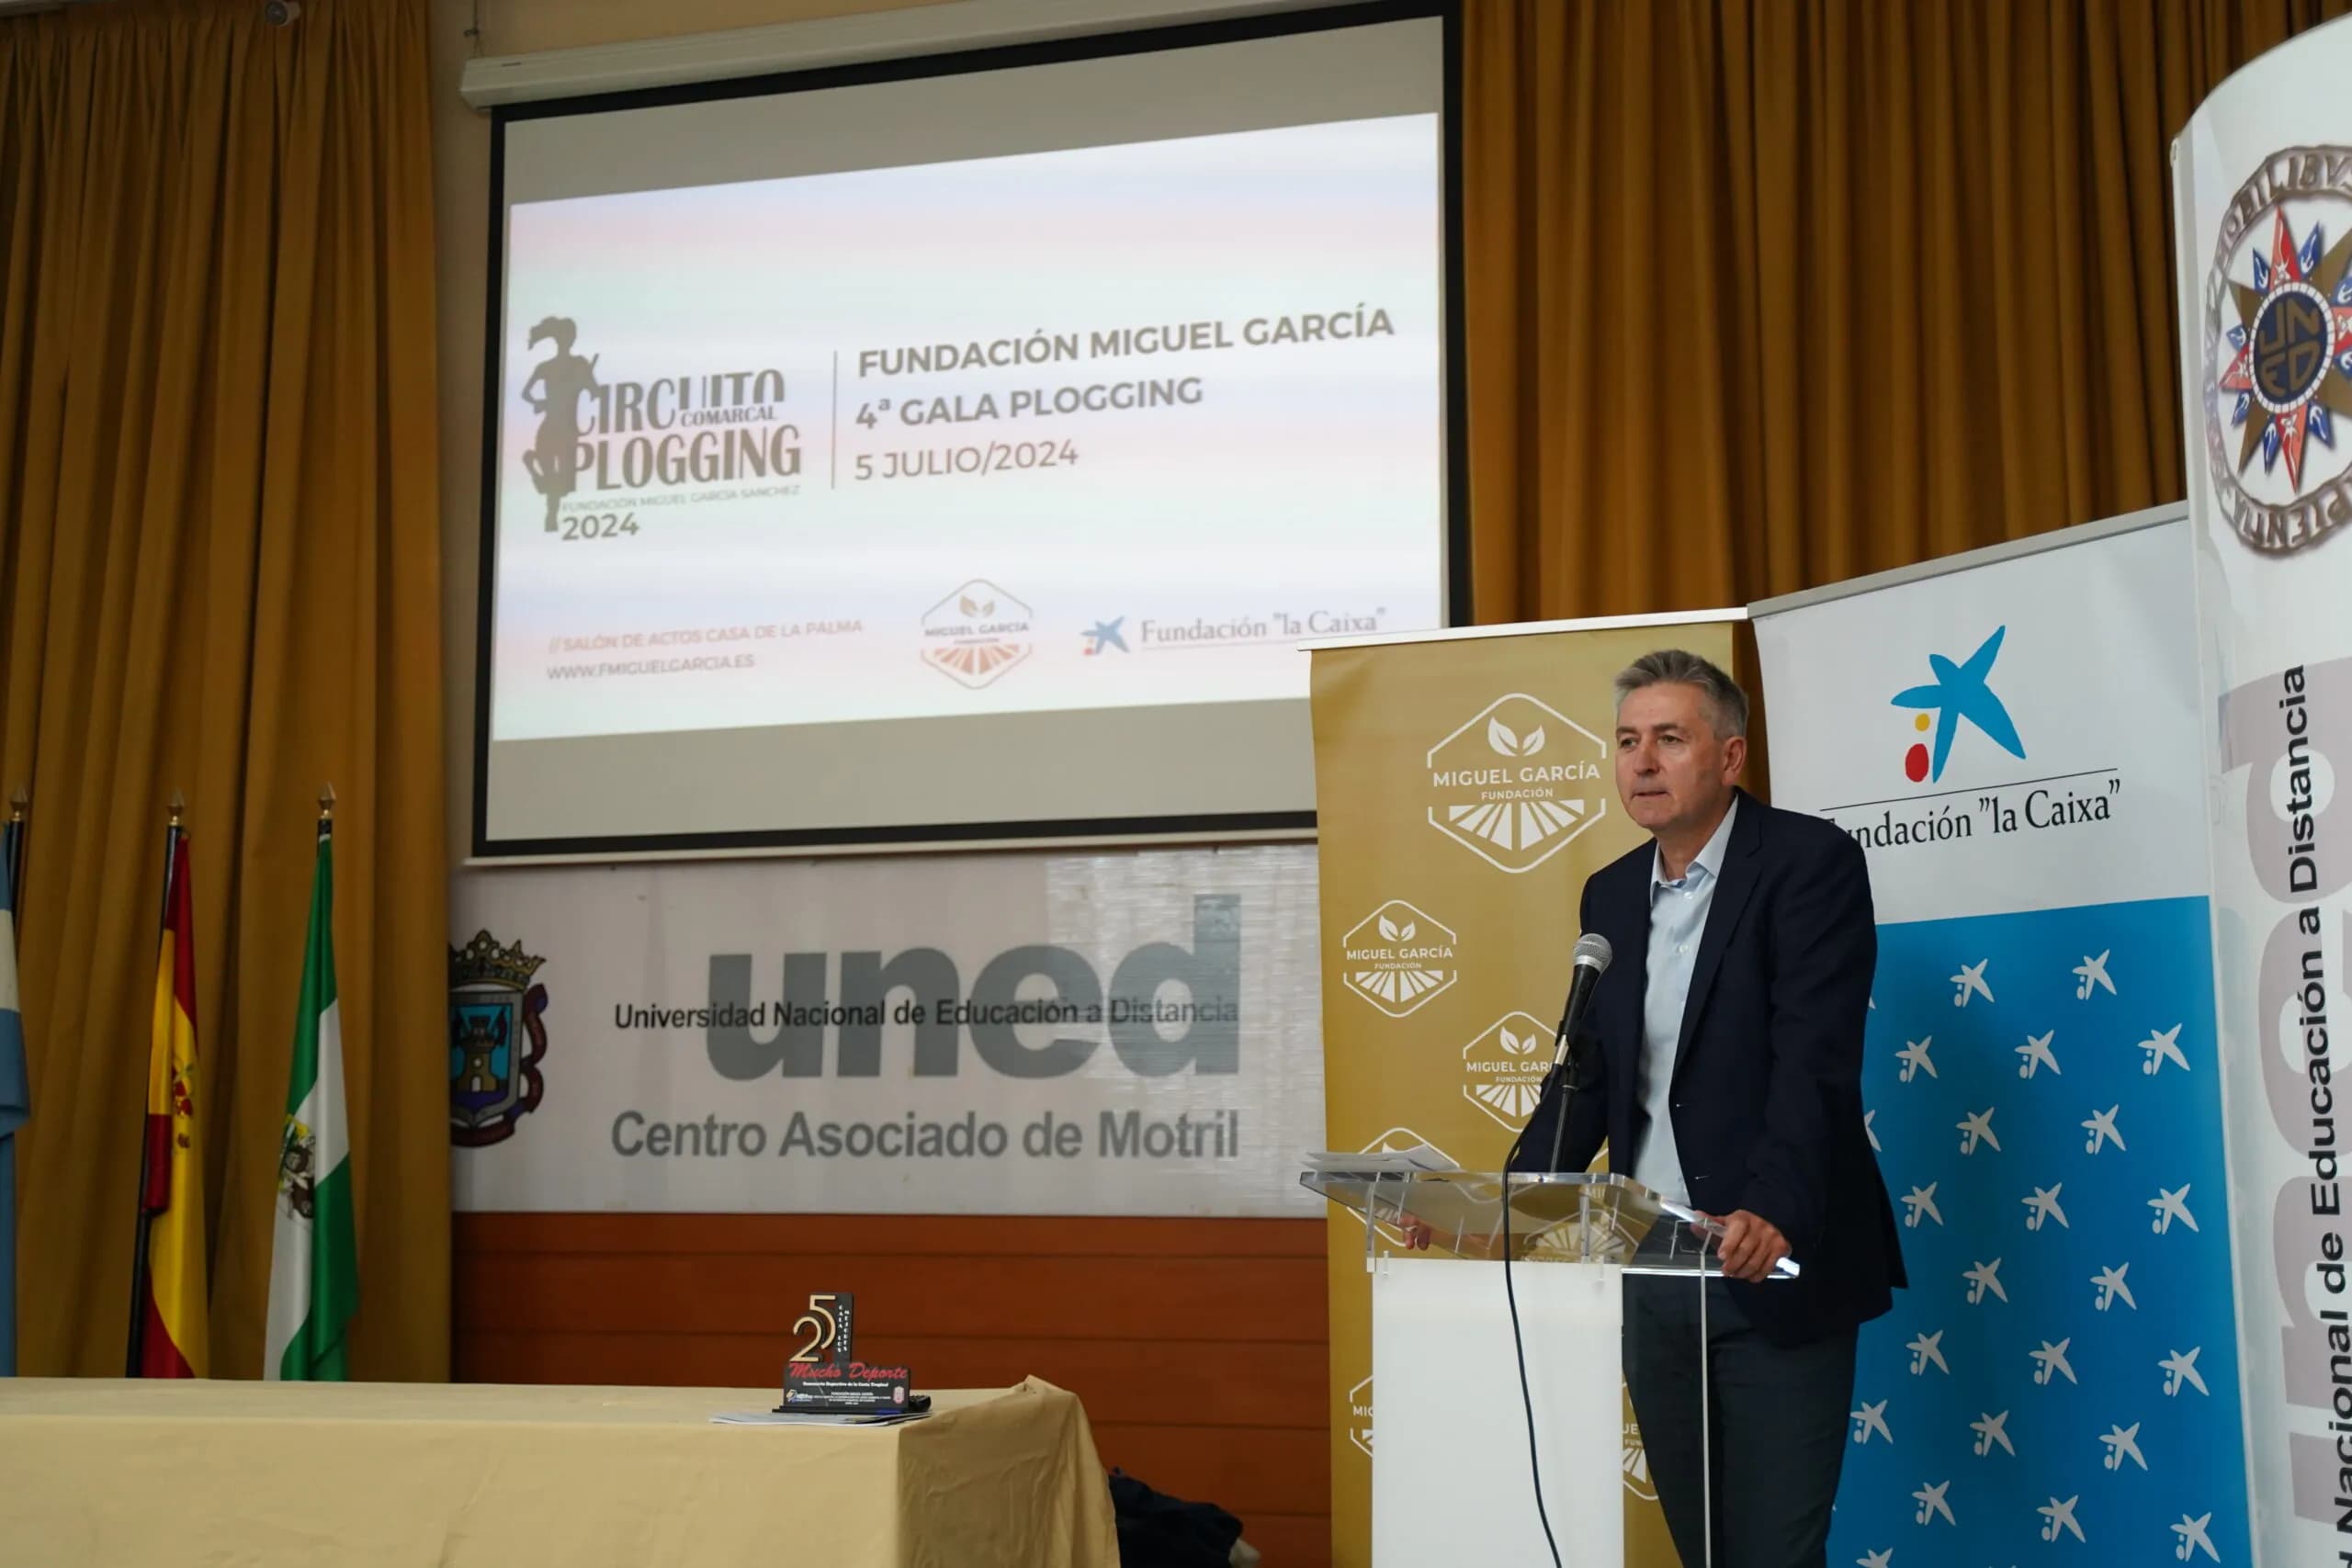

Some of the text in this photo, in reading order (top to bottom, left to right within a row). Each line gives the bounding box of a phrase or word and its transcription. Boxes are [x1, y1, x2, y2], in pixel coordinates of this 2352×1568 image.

[859, 302, 1395, 378] FUNDACIÓN MIGUEL GARCÍA
[575, 368, 786, 437] CIRCUITO
[681, 405, 778, 428] COMARCAL
[900, 394, 999, 426] GALA
[1010, 377, 1203, 419] PLOGGING
[575, 424, 801, 491] PLOGGING
[854, 439, 1079, 480] 5 JULIO/2024
[562, 513, 640, 541] 2024
[623, 635, 647, 649] DE
[649, 630, 704, 645] ACTOS
[706, 627, 751, 643] CASA
[754, 626, 776, 638] DE
[781, 623, 801, 637] LA
[806, 620, 863, 635] PALMA
[925, 626, 972, 637] MIGUEL
[1142, 616, 1267, 643] Fundación
[1433, 761, 1600, 787] MIGUEL GARCÍA
[2279, 664, 2317, 894] Distancia
[1481, 787, 1554, 800] FUNDACIÓN
[1826, 805, 1973, 849] ndación
[2299, 907, 2321, 935] a
[1346, 944, 1453, 960] MIGUEL GARCÍA
[707, 894, 1240, 1081] uned
[616, 996, 1238, 1029] Universidad Nacional de Educación a Distancia
[1466, 1061, 1554, 1073] MIGUEL GAR
[2298, 949, 2341, 1215] Educación
[611, 1110, 1238, 1158] Centro Asociado de Motril
[2316, 1232, 2346, 1293] de
[789, 1294, 836, 1362] 25
[789, 1361, 908, 1382] Mucho Deporte
